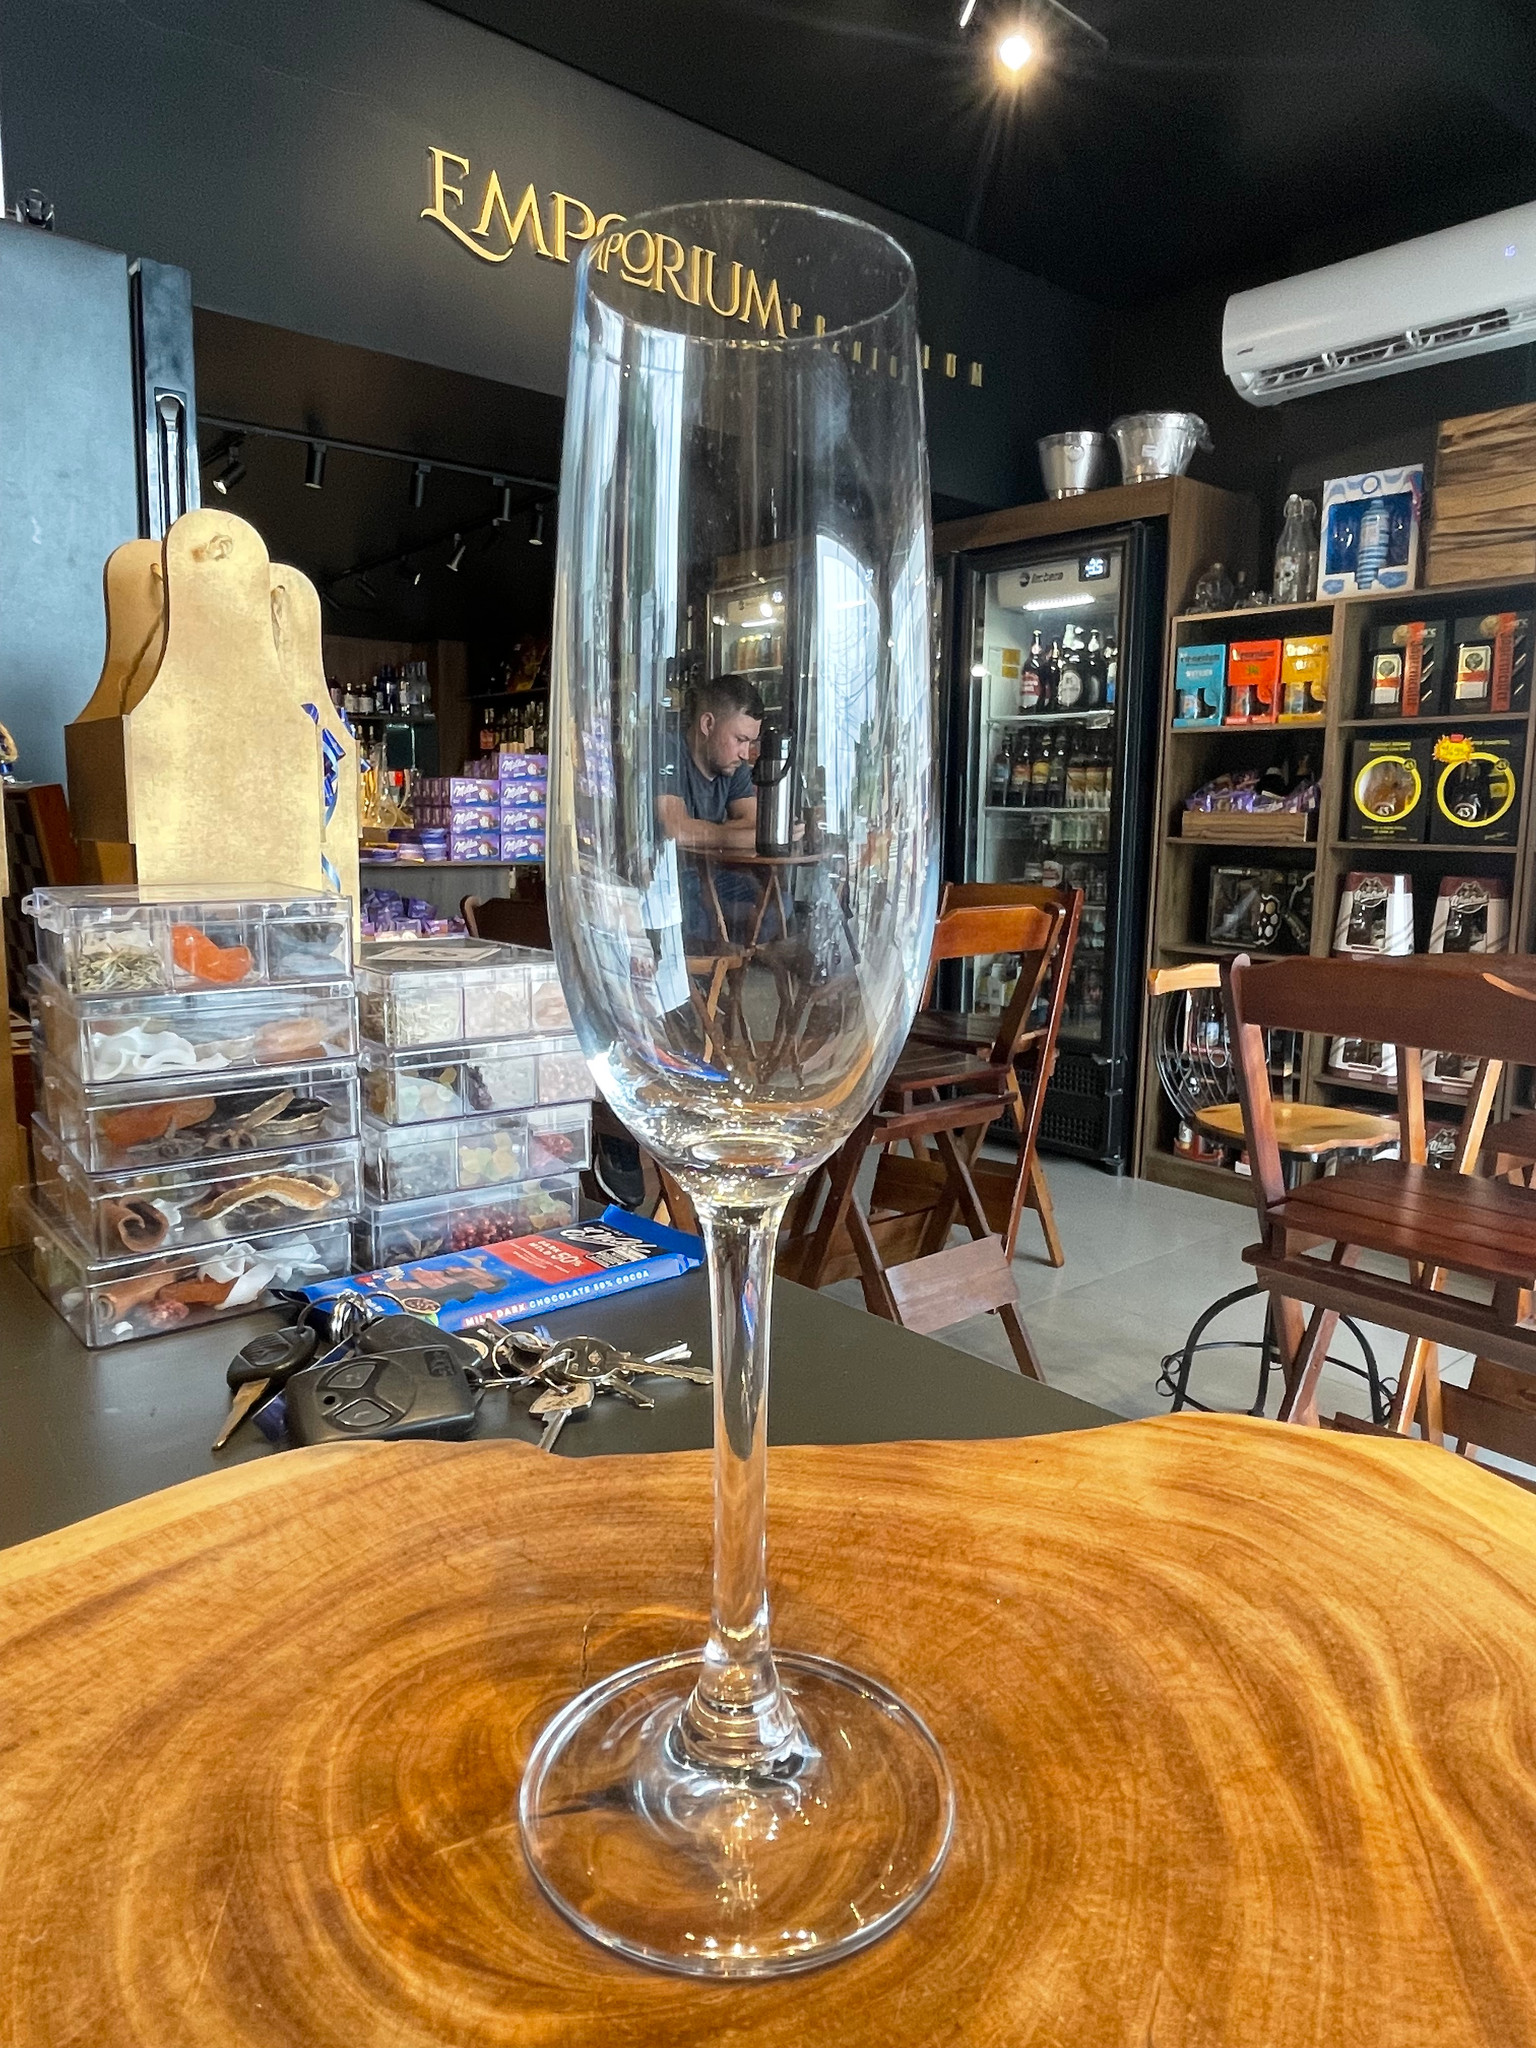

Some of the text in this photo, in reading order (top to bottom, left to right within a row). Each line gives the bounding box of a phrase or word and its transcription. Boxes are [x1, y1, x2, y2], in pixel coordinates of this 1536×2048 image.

[501, 758, 528, 772] Milka
[453, 783, 479, 798] Milka
[503, 785, 529, 799] Milka
[453, 811, 480, 825] Milka
[503, 812, 528, 826] Milka
[453, 838, 479, 853] Milka
[503, 838, 529, 852] Milka
[465, 1269, 651, 1327] MILD DARK CHOCOLATE 50% COCOA
